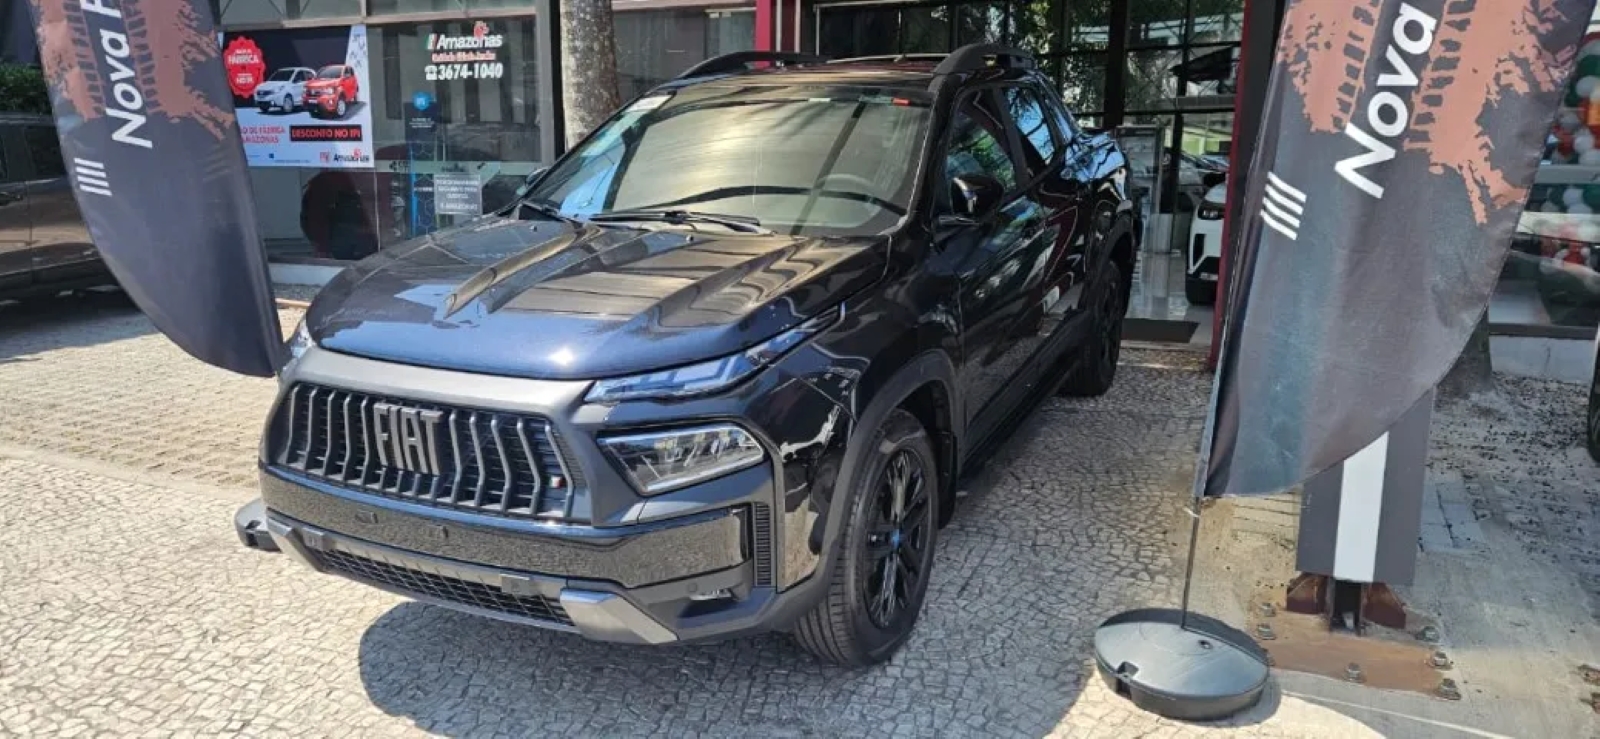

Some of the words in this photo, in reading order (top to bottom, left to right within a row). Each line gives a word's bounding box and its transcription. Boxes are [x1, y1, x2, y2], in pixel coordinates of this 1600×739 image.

[436, 33, 503, 50] Amazonas
[100, 29, 153, 149] Nova
[438, 63, 504, 80] 3674-1040
[1335, 2, 1438, 199] Nova
[291, 128, 333, 139] DESCONTO
[334, 128, 348, 138] NO
[350, 128, 361, 138] IPI
[373, 403, 444, 477] FIAT
